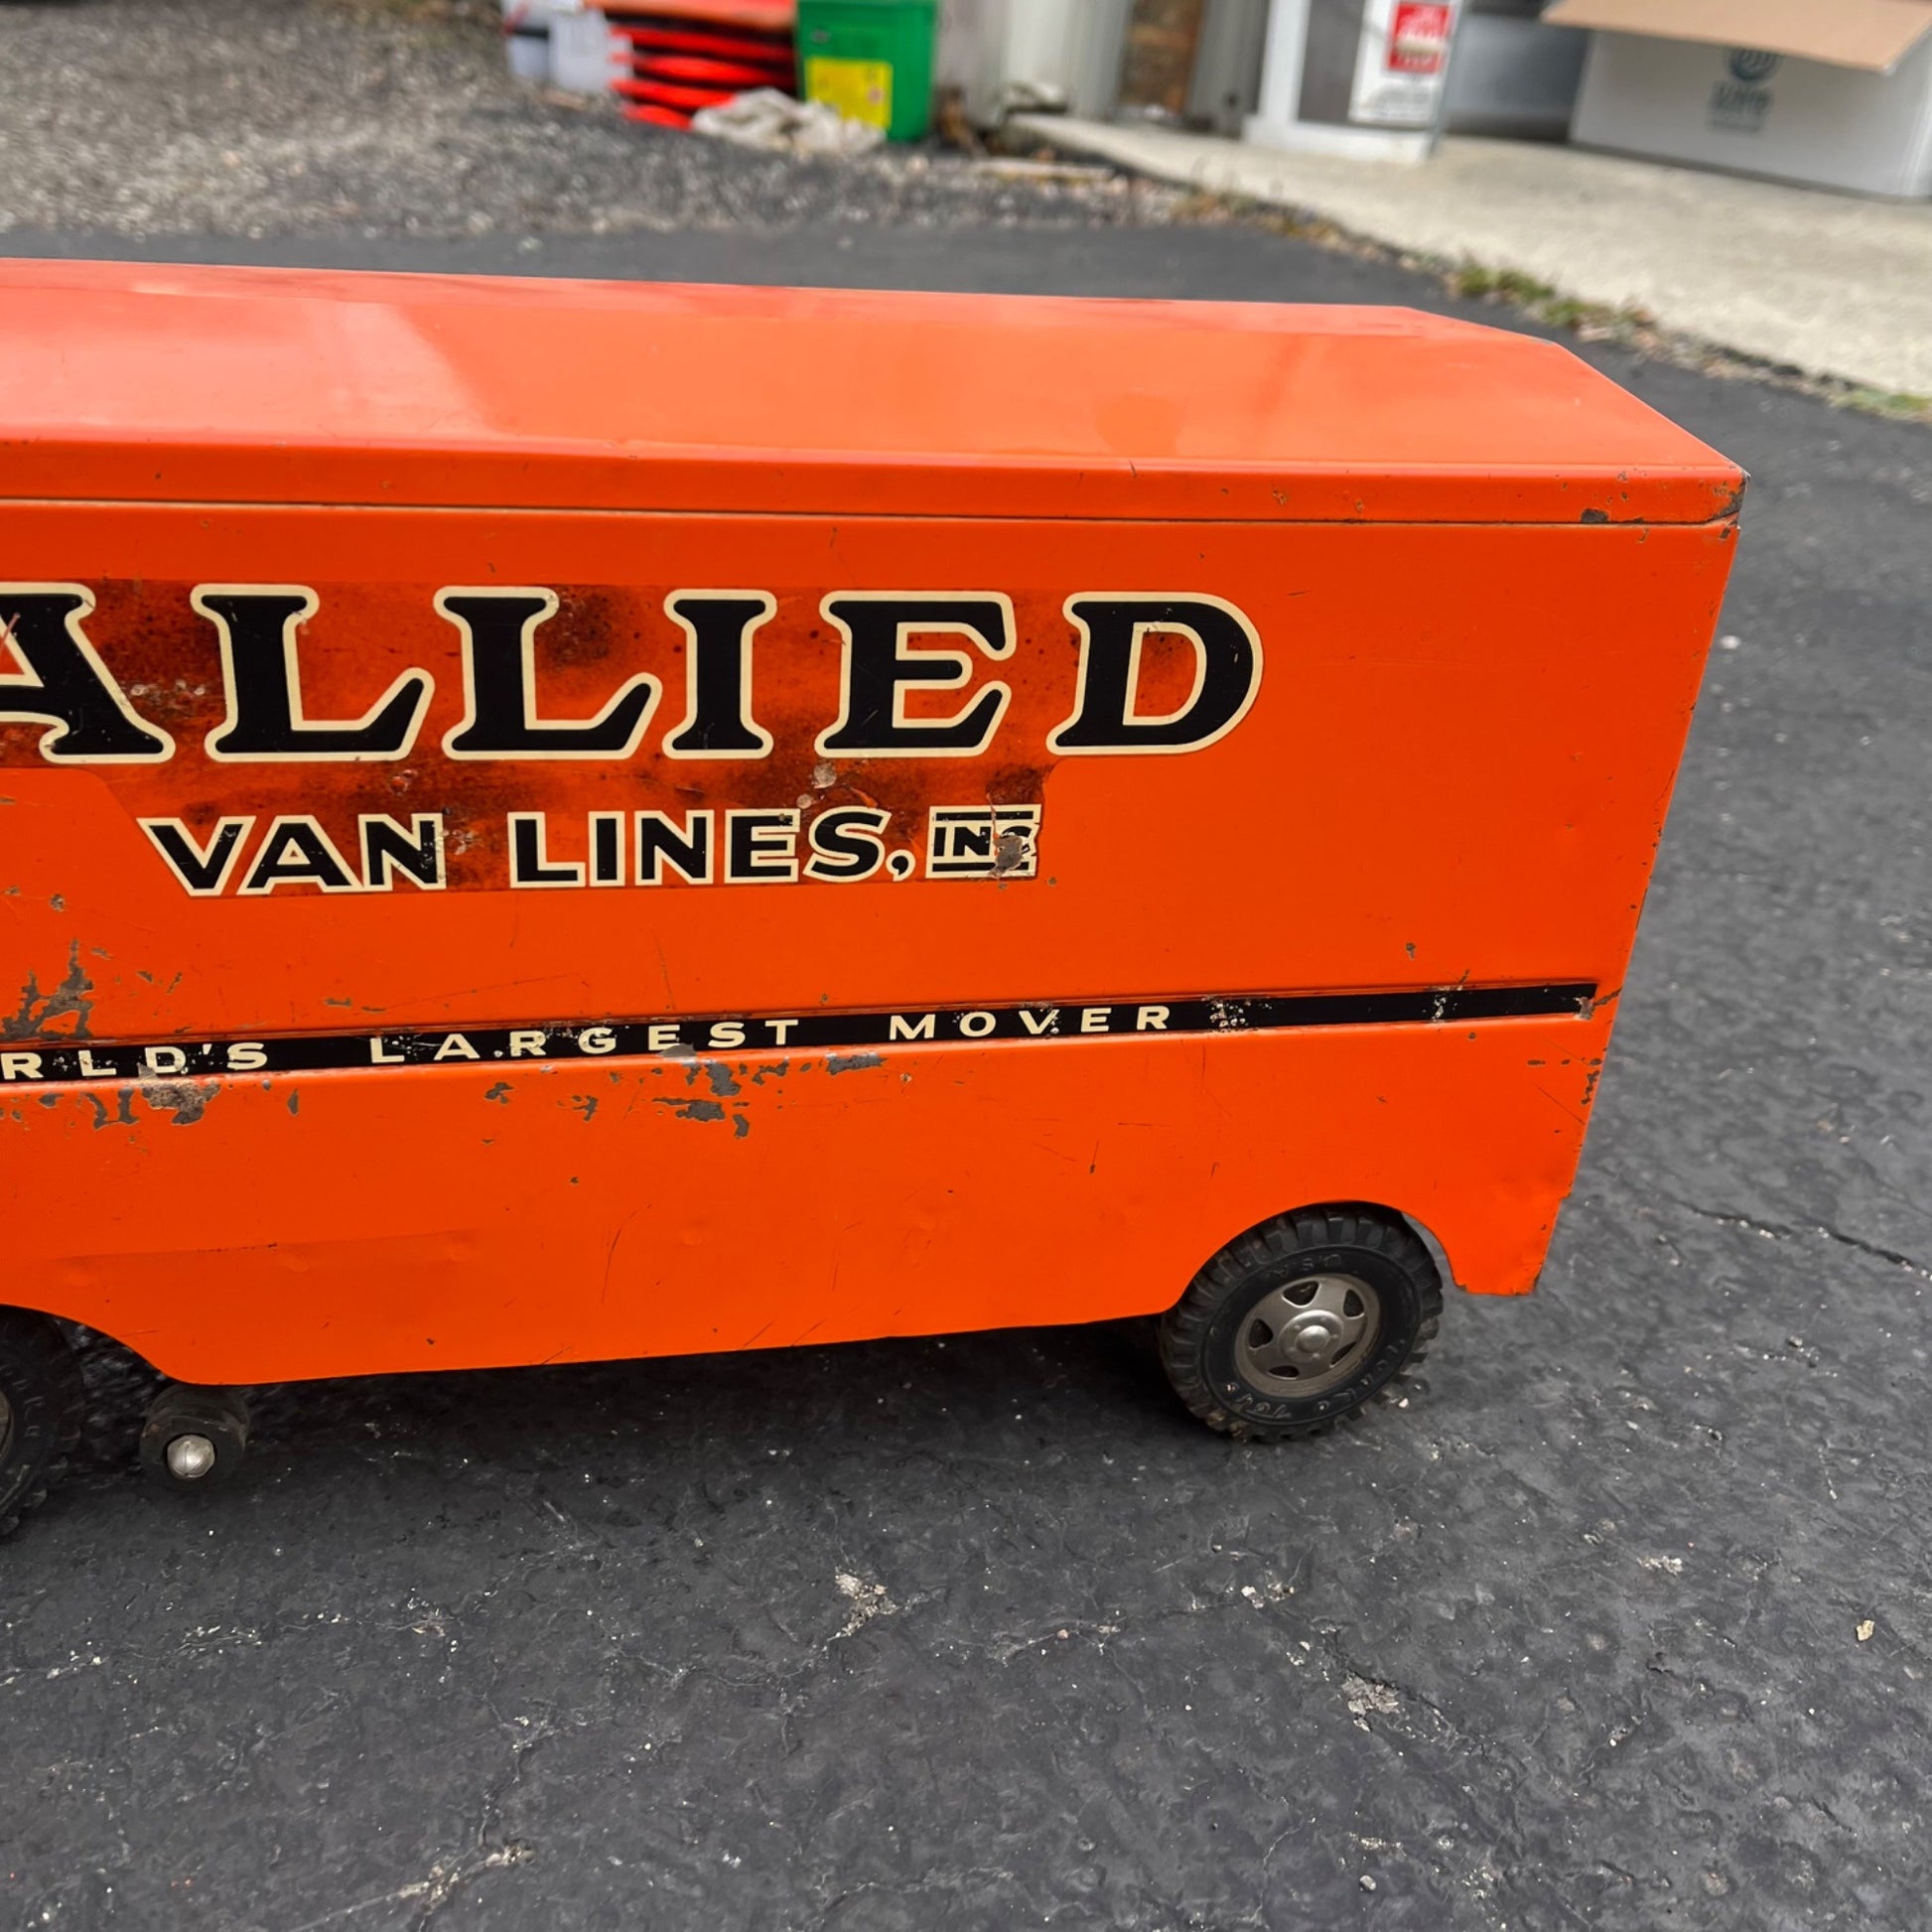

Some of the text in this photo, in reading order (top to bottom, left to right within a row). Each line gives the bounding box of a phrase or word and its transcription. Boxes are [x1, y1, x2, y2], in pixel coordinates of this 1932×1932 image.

[0, 582, 1264, 764] ALLIED
[136, 813, 447, 897] VAN
[507, 805, 914, 887] LINES,
[0, 1005, 1171, 1080] RLD'S LARGEST MOVER
